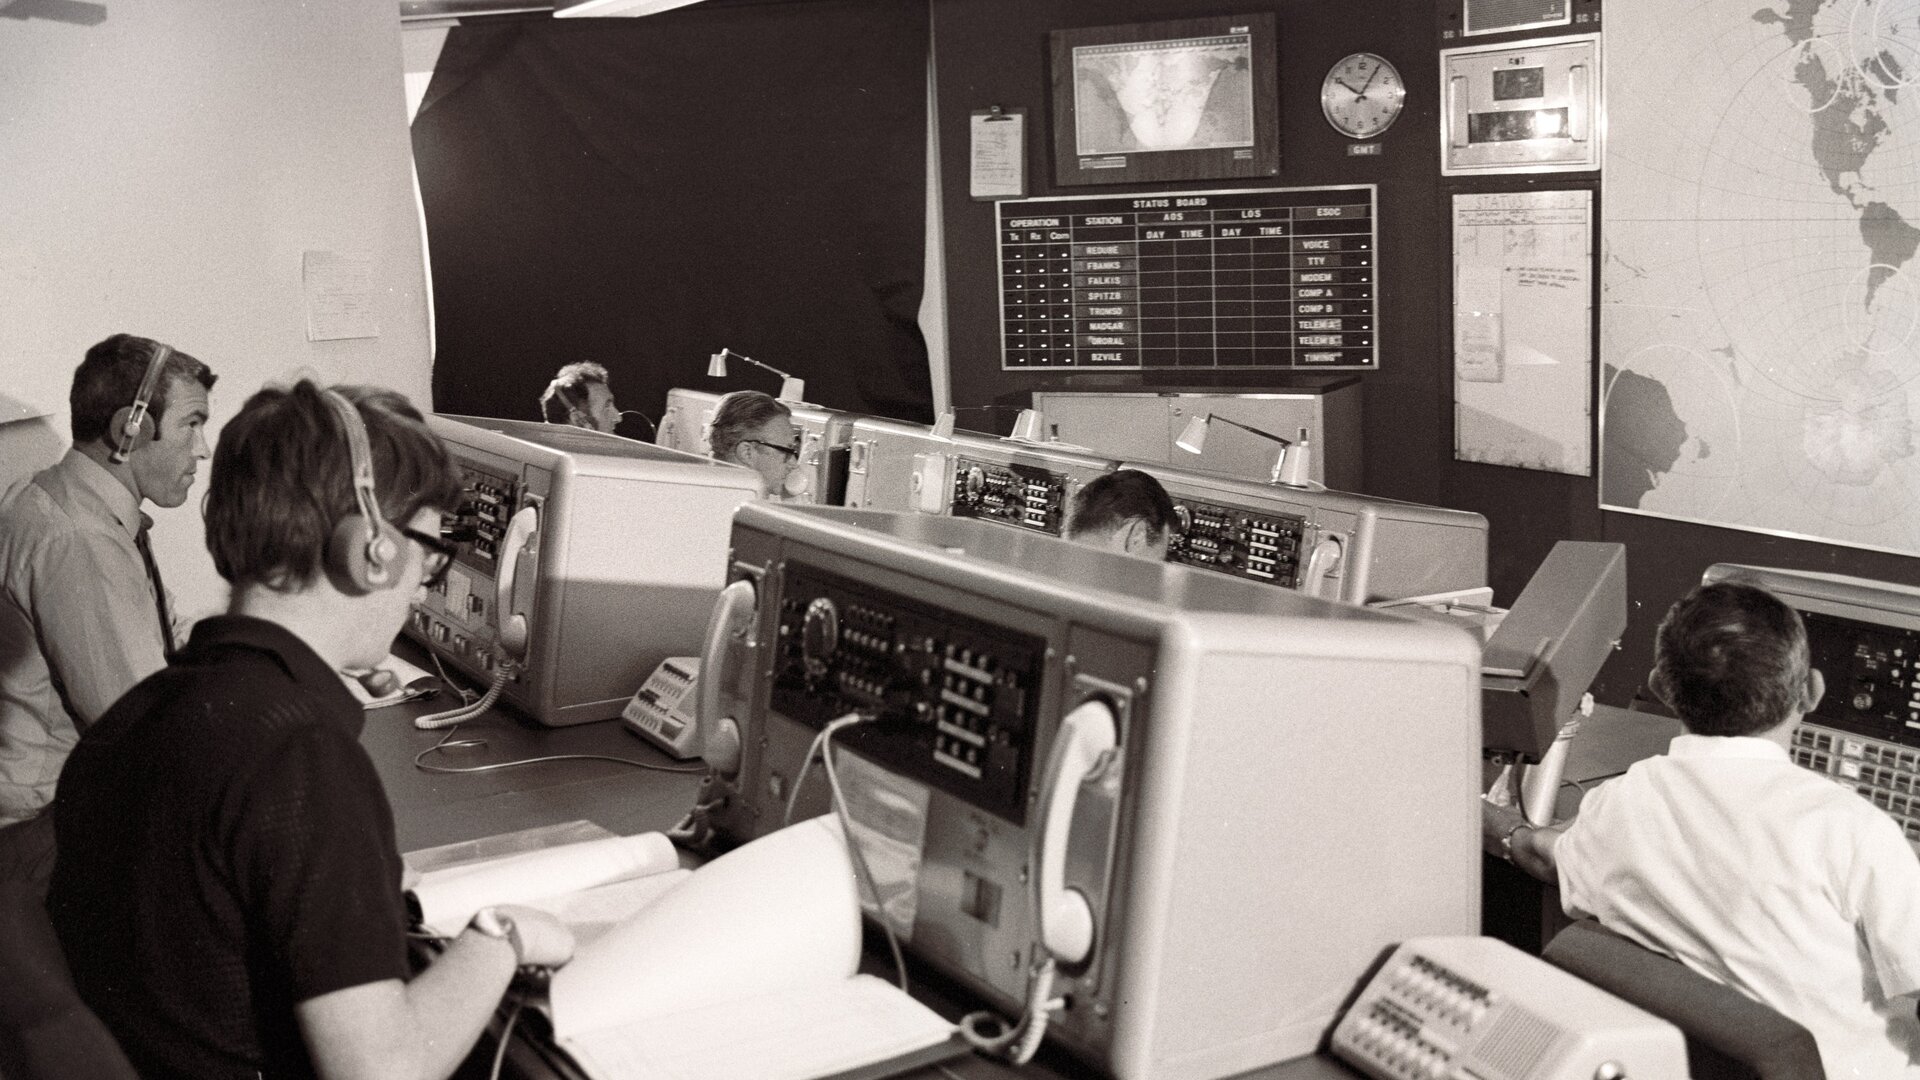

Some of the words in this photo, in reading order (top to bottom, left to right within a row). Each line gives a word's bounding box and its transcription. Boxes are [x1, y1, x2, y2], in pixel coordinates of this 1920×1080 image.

[1359, 62, 1367, 70] 12
[1353, 145, 1374, 154] GMT
[1133, 199, 1169, 208] STATUS
[1176, 197, 1207, 207] BOARD
[1163, 212, 1184, 221] AOS
[1241, 209, 1262, 219] LOS
[1316, 208, 1341, 217] ESOC
[1010, 218, 1059, 228] OPERATION
[1085, 216, 1123, 226] STATION
[1146, 230, 1165, 240] DAY
[1181, 229, 1204, 238] TIME
[1221, 227, 1242, 237] DAY
[1259, 226, 1283, 236] TIME
[1030, 231, 1041, 241] Rx
[1302, 240, 1330, 249] VOICE
[1087, 261, 1120, 270] FBANKS
[1307, 256, 1326, 266] TTY
[1088, 276, 1120, 285] FALKIS
[1301, 273, 1332, 282] MODEM
[1298, 288, 1323, 297] COMP
[1325, 288, 1333, 297] A
[1298, 304, 1323, 313] COMP
[1325, 304, 1333, 313] B
[1299, 320, 1327, 329] TELEM
[1299, 336, 1328, 345] TELEM
